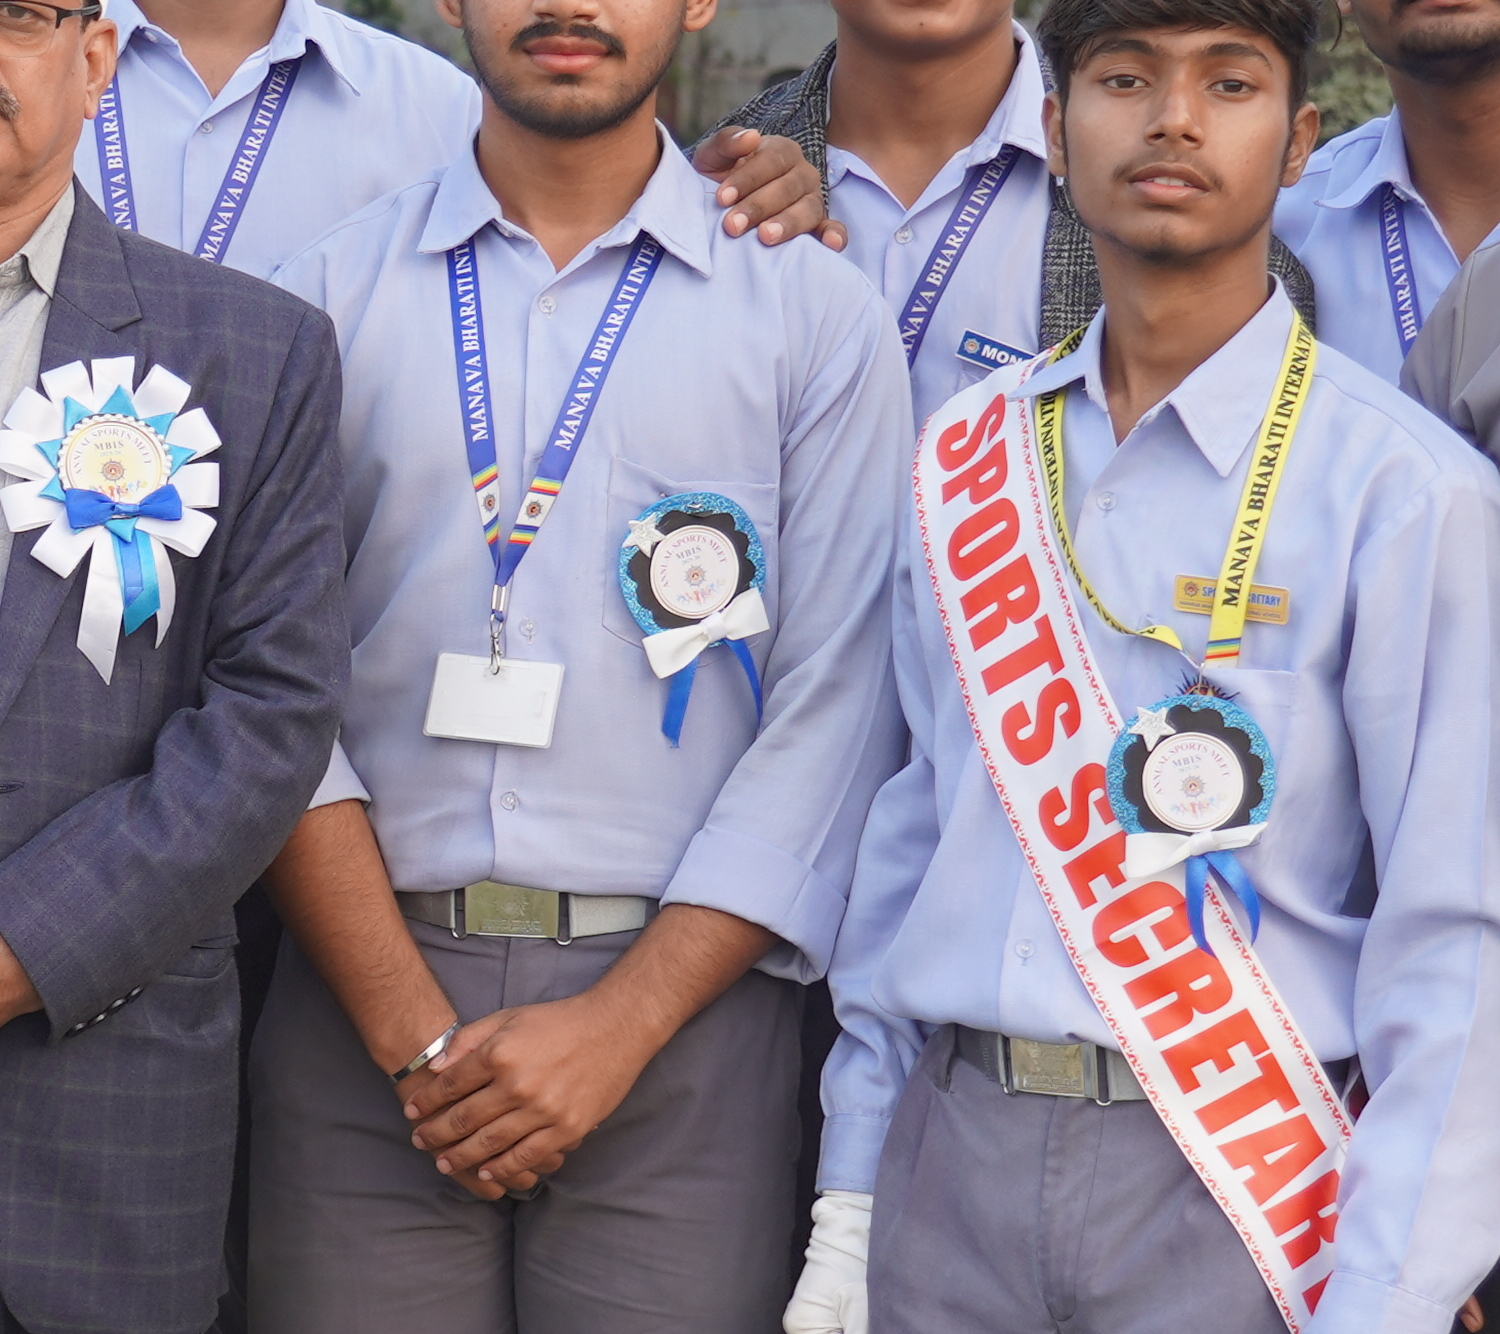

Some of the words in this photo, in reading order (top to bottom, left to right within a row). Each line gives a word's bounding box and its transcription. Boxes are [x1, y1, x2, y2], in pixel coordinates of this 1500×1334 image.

[100, 92, 125, 170] BHARATI
[200, 186, 244, 263] MANAVA
[231, 107, 275, 184] BHARATI
[262, 58, 296, 110] INTER
[108, 172, 132, 231] NAVA
[925, 207, 978, 287] BHARATI
[457, 275, 481, 353] BHARATI
[1387, 249, 1418, 342] BHARATI
[464, 353, 489, 443] MANAVA
[553, 364, 603, 452] MANAVA
[589, 284, 638, 363] BHARATI
[91, 428, 132, 440] SPORTS
[93, 440, 125, 451] MBIS
[1221, 516, 1261, 609] MANAVA
[1246, 419, 1289, 513] BHARATI
[675, 547, 702, 560] MBIS
[1168, 742, 1209, 755] SPORTS
[1171, 755, 1203, 767] MBIS
[936, 391, 1084, 767] SPORTS
[1037, 762, 1347, 1318] SECRETAR
